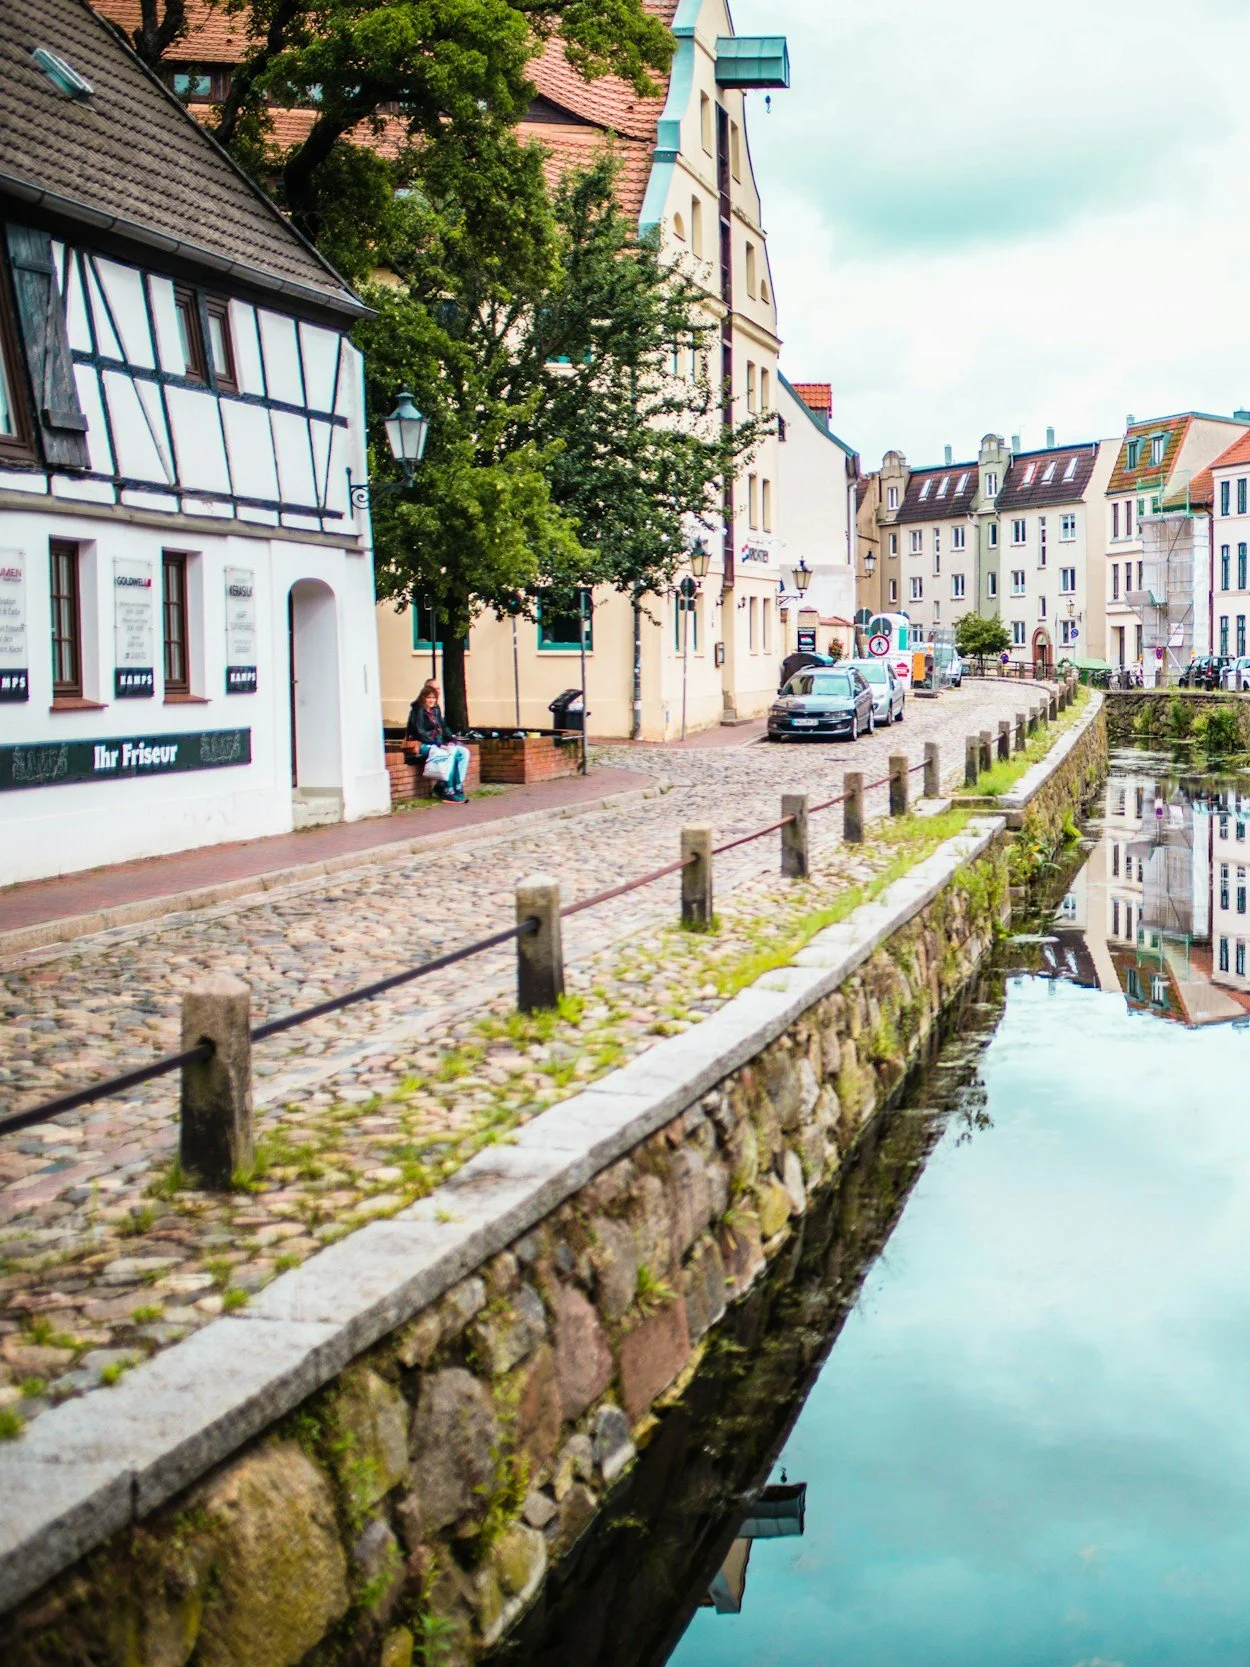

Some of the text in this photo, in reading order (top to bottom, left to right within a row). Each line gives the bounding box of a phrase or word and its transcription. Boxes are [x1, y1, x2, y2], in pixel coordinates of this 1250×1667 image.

[116, 576, 147, 588] GOLDWELL
[119, 675, 153, 686] KAMPS
[230, 672, 257, 683] KAMPS
[94, 744, 119, 769] Ihr
[121, 741, 178, 767] Friseur
